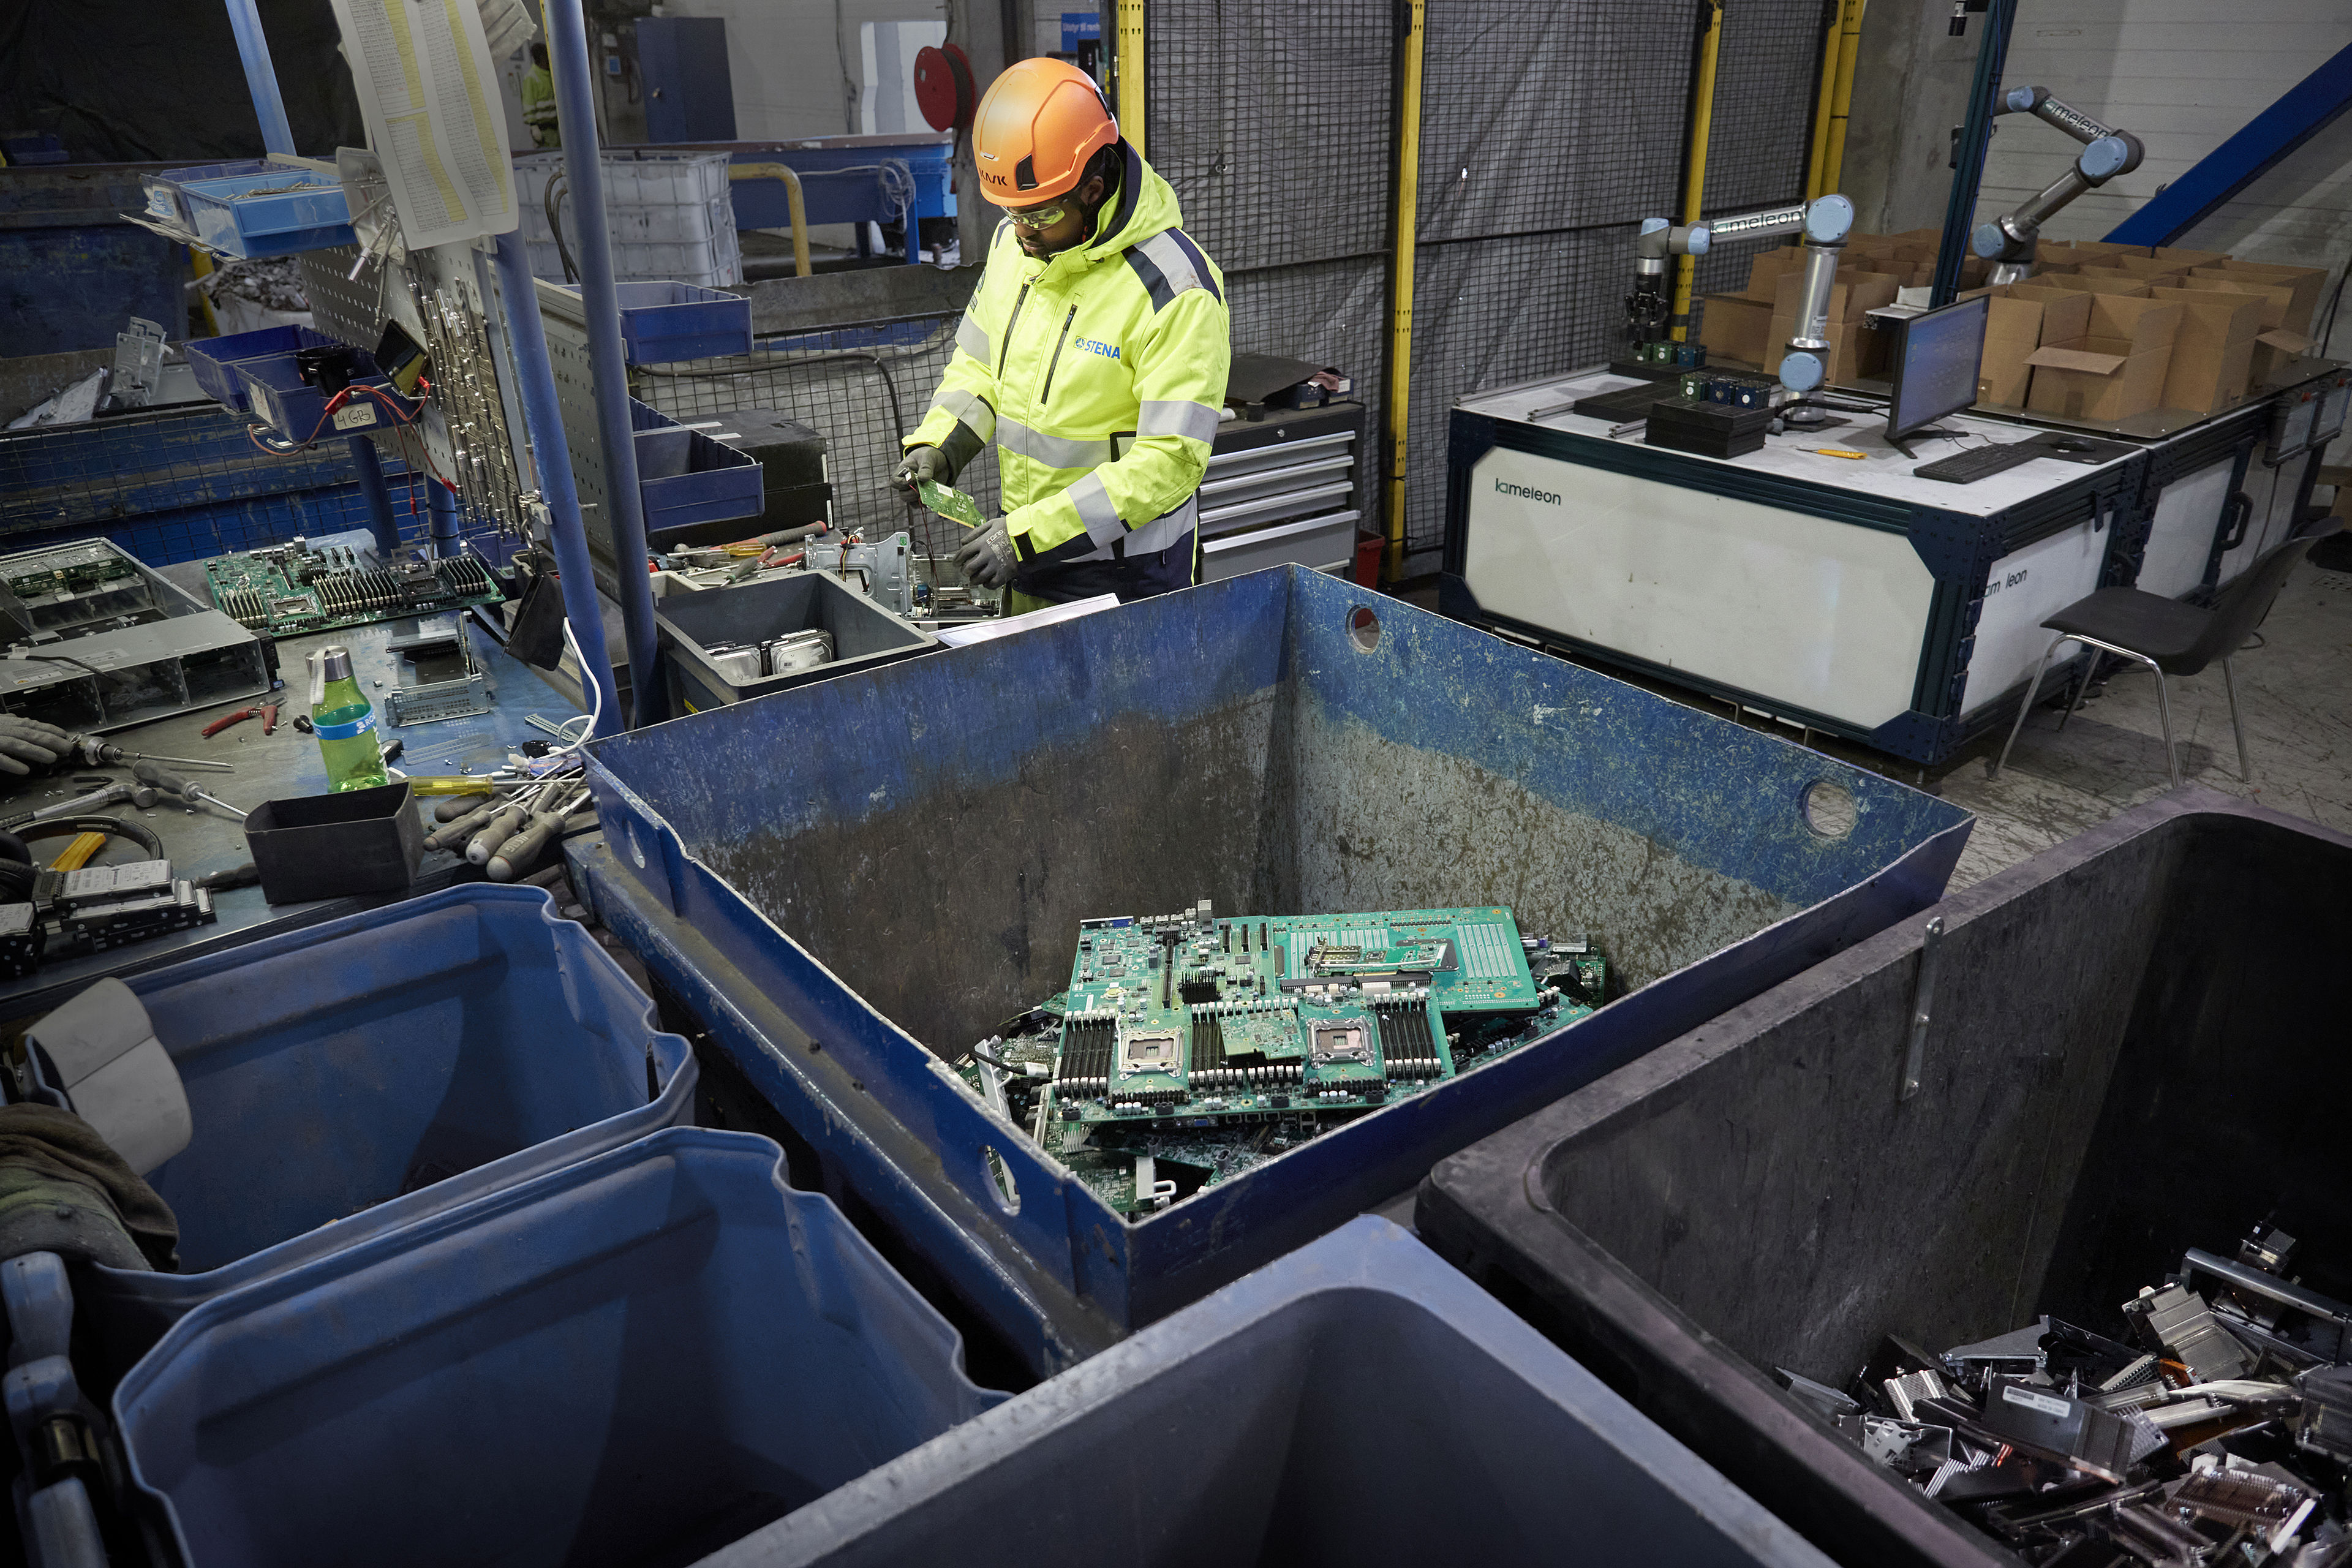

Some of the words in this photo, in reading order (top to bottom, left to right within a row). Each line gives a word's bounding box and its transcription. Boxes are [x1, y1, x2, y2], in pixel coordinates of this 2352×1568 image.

[1711, 211, 1801, 236] kameleon
[1084, 340, 1120, 360] STENA
[337, 412, 347, 427] 4
[349, 409, 371, 424] GB
[1495, 478, 1561, 505] kameleon
